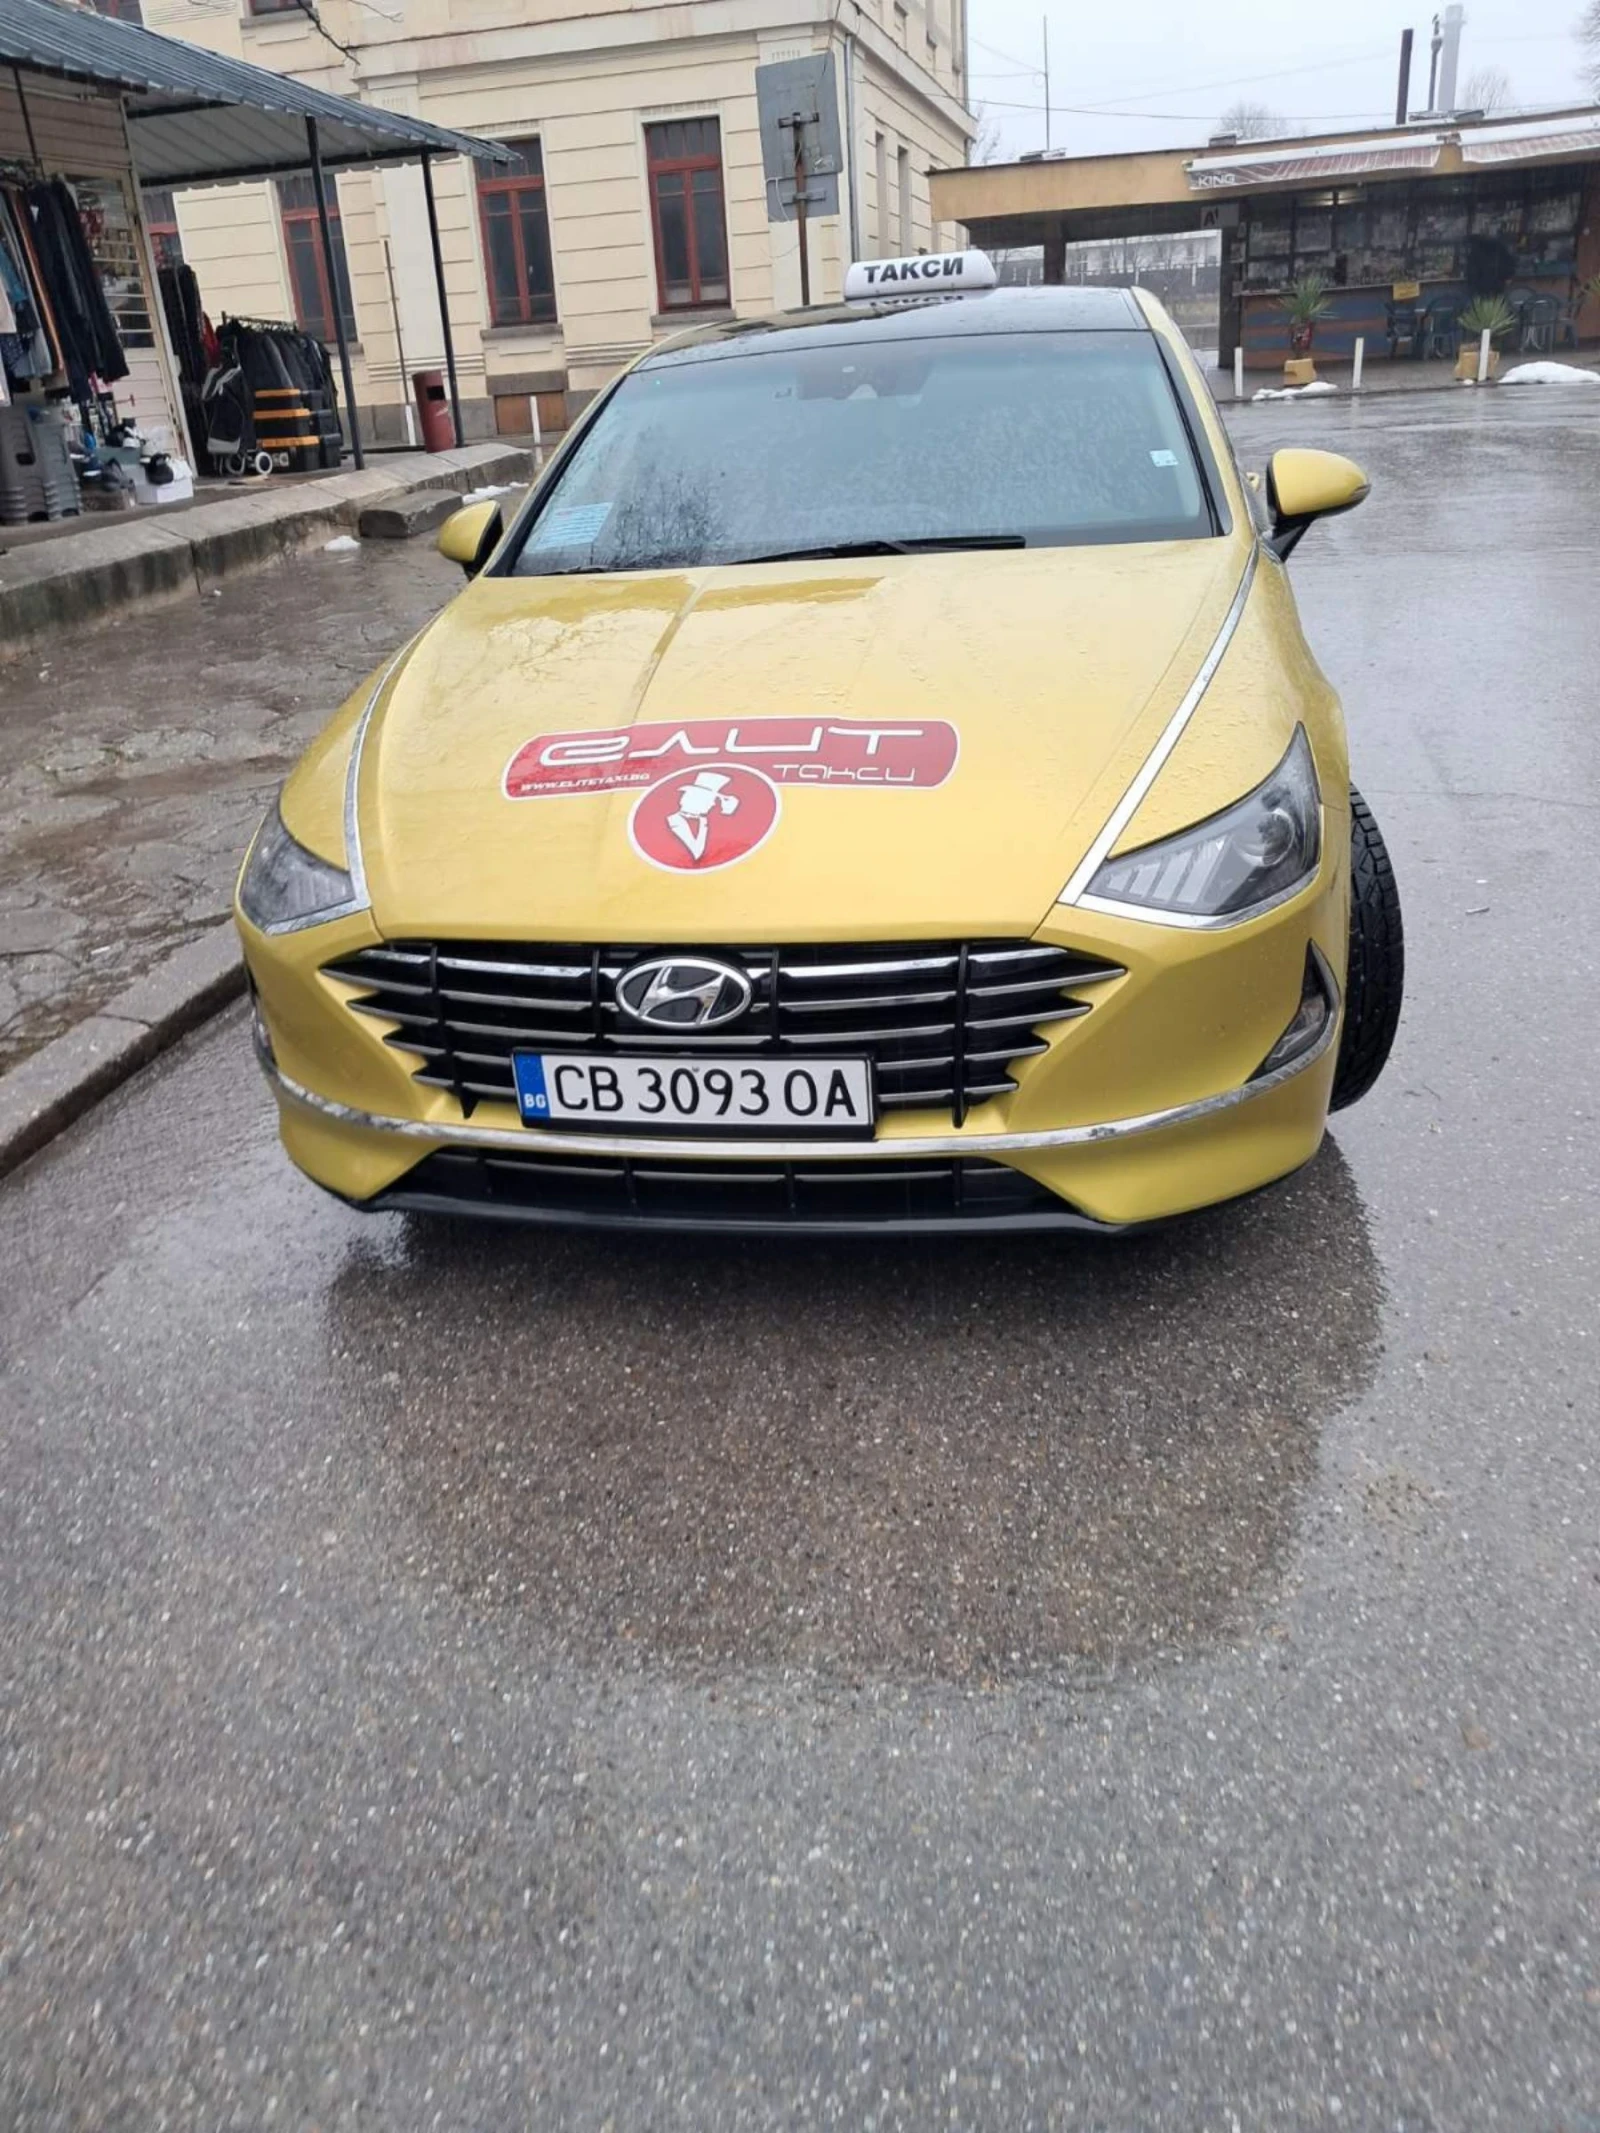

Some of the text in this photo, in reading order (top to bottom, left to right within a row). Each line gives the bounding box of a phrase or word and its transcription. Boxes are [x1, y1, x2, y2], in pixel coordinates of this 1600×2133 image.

[864, 257, 964, 284] ТАКСИ
[523, 1093, 547, 1109] BG
[637, 1067, 770, 1117] 3093
